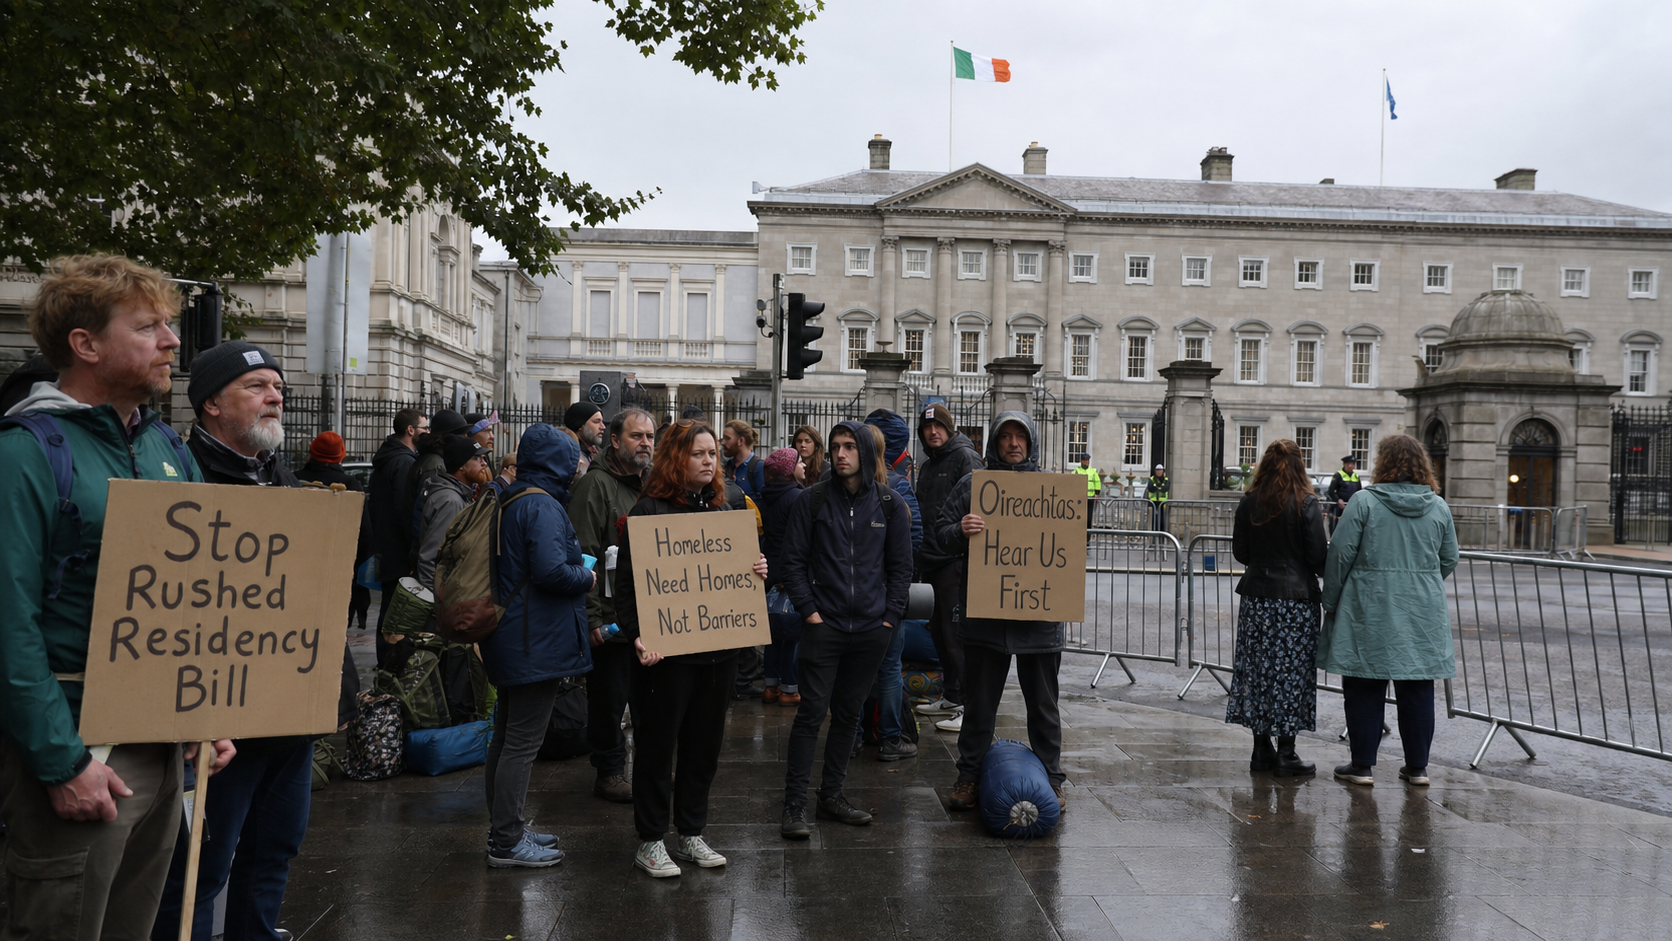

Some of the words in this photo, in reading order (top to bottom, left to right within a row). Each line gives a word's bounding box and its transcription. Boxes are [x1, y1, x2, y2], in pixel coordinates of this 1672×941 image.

[980, 480, 1081, 520] Oireachtas:
[164, 501, 289, 577] Stop
[655, 527, 731, 557] Homeless
[985, 529, 1033, 566] Hear
[1040, 532, 1066, 568] Us
[126, 564, 285, 611] Rushed
[646, 568, 689, 595] Need
[698, 564, 757, 592] Homes,
[1001, 575, 1051, 611] First
[658, 607, 691, 635] Not
[698, 604, 757, 631] Barriers
[110, 615, 320, 674] Residency
[176, 664, 248, 713] Bill
